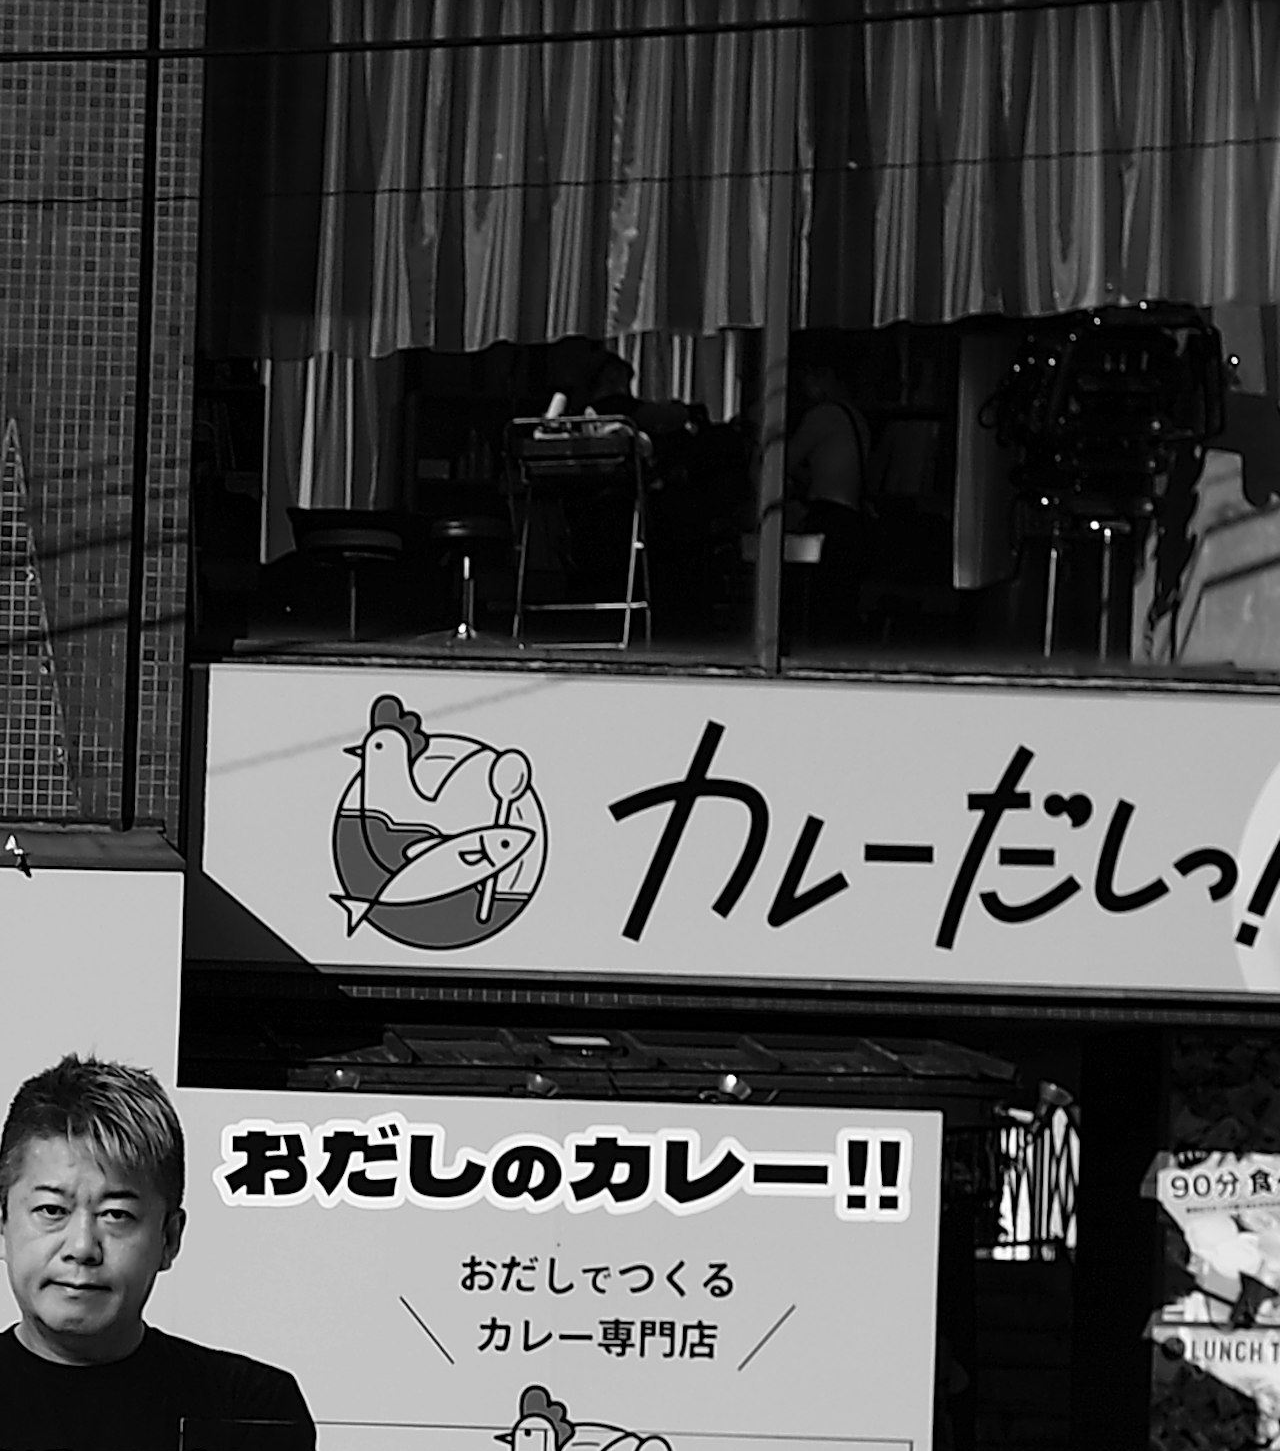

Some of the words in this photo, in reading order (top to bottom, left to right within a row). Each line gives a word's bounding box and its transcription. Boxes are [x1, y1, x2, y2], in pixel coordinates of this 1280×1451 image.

[459, 1254, 736, 1297] おだしでつくる
[477, 1316, 719, 1359] カレー専門店
[1191, 1339, 1262, 1363] LUNCH
